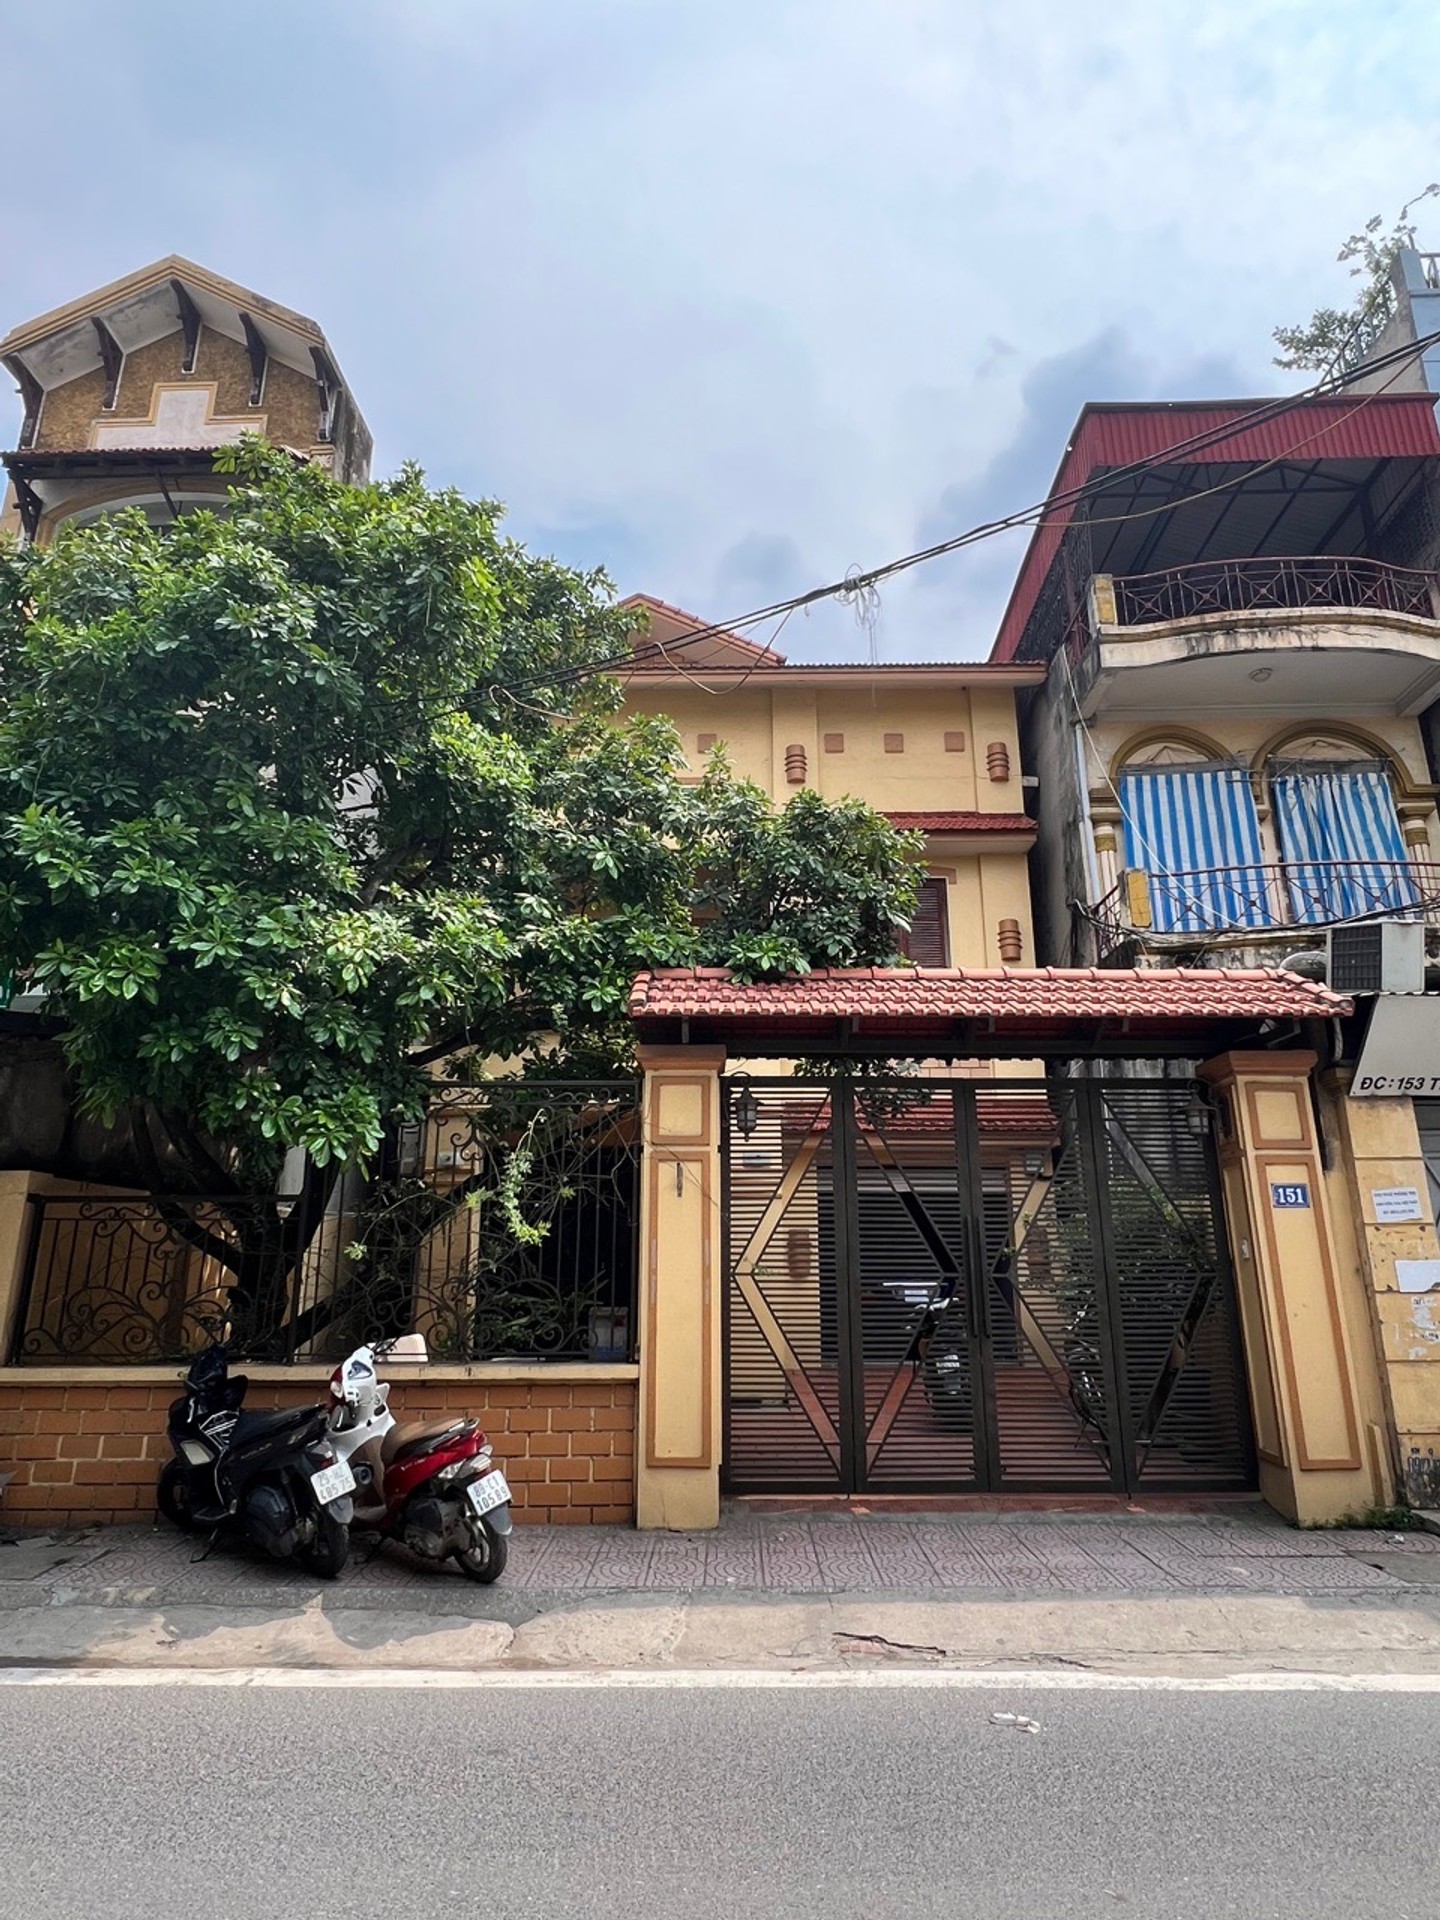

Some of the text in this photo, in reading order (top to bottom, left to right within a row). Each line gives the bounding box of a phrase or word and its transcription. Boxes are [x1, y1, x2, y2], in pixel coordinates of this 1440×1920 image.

[1398, 1077, 1425, 1090] 153
[1430, 1077, 1440, 1090] T
[1277, 1188, 1304, 1203] 151
